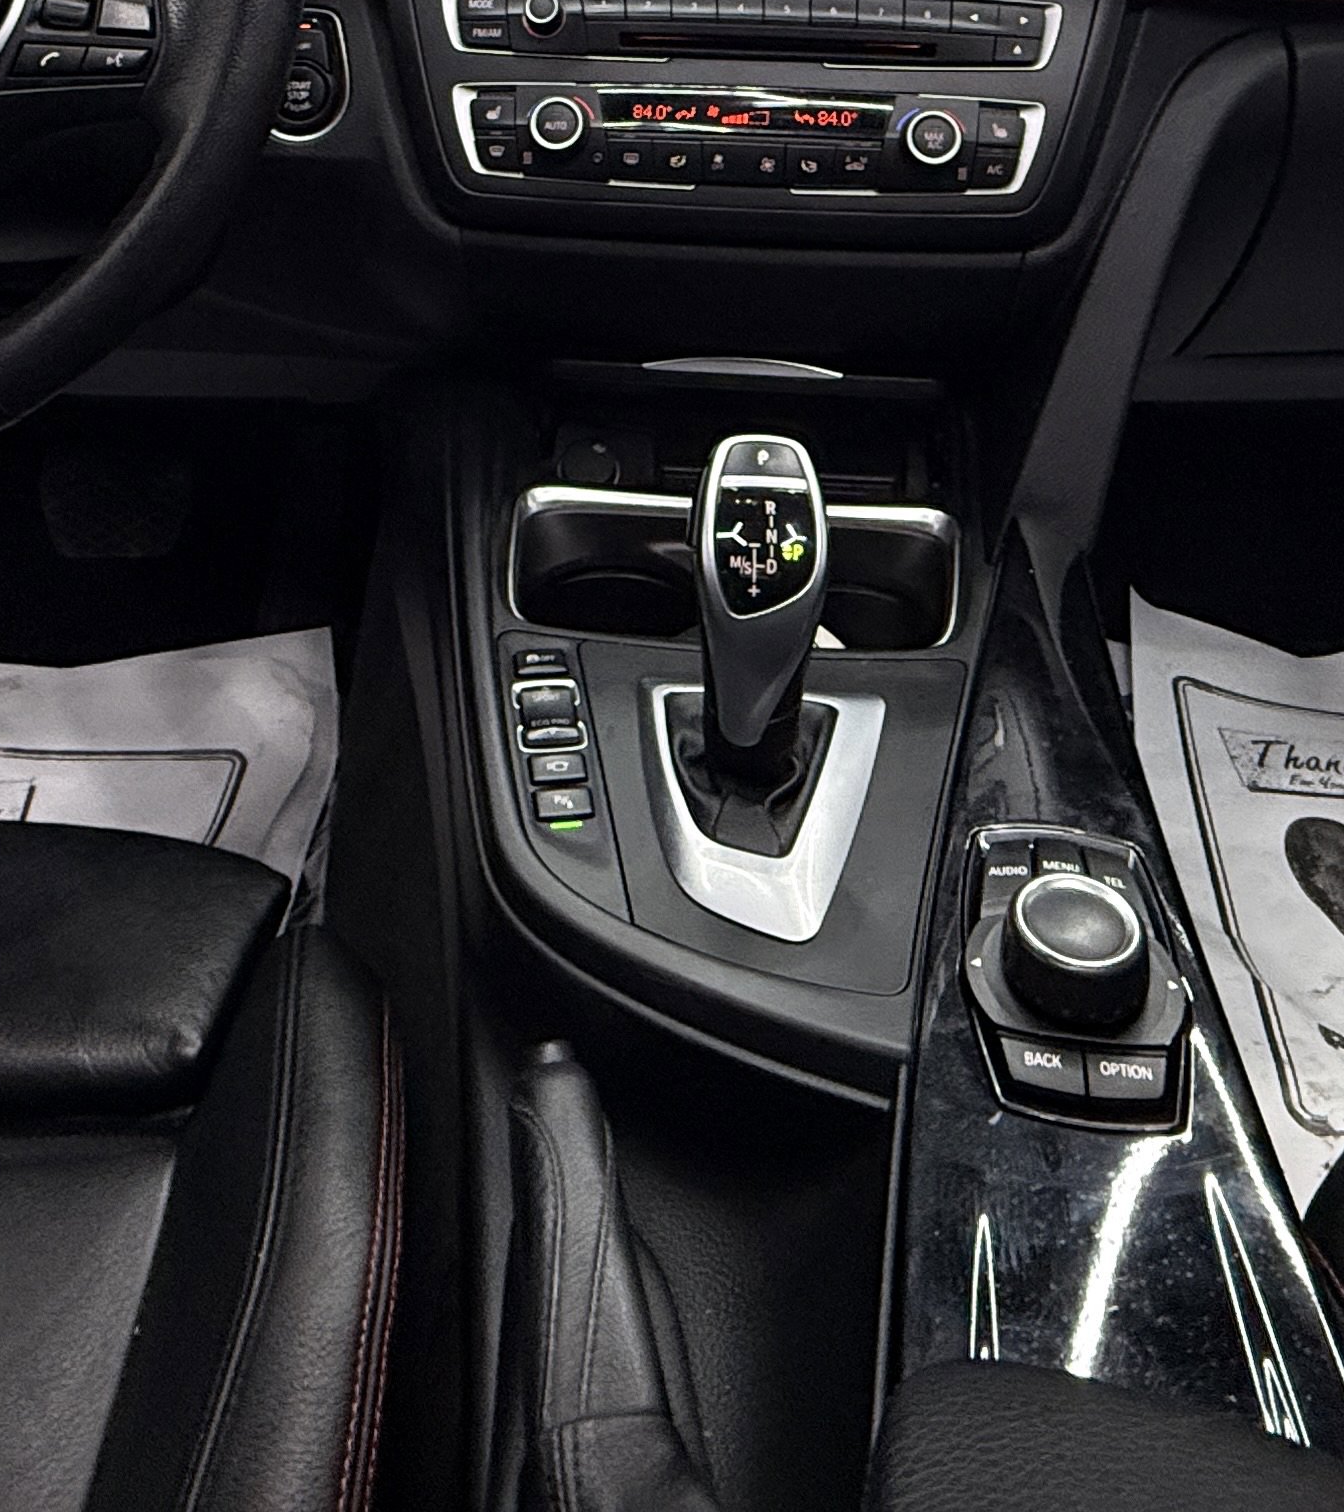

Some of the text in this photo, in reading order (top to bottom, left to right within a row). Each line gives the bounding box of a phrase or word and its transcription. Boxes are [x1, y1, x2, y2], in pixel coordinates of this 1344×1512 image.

[468, 0, 494, 9] MODE
[543, 120, 568, 131] AUTO
[986, 163, 1005, 176] A/C
[756, 449, 770, 466] P
[764, 500, 777, 515] R
[765, 528, 778, 544] N
[765, 558, 778, 575] D
[988, 864, 1028, 877] AUDIO
[1042, 860, 1081, 874] MENU
[1103, 875, 1127, 890] TEL
[1023, 1050, 1063, 1070] BACK
[1098, 1060, 1155, 1081] OPTION
